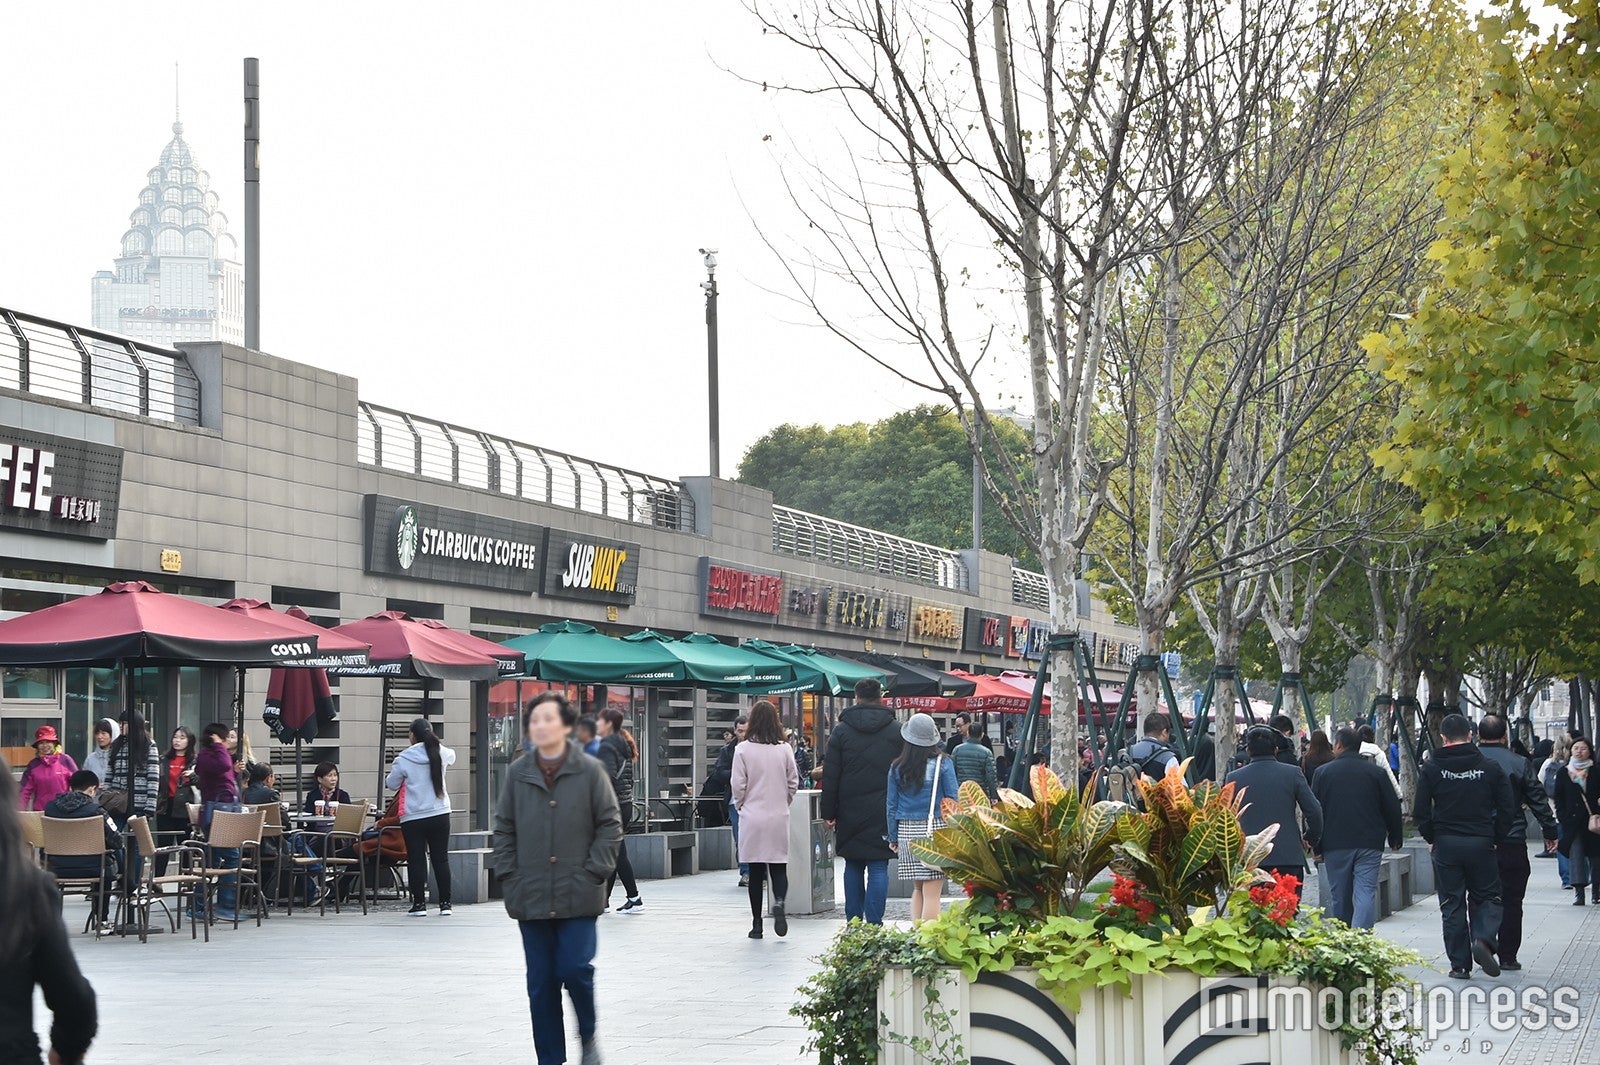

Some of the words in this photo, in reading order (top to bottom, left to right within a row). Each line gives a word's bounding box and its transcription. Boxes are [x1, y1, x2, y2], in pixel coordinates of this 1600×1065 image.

[421, 527, 493, 563] STARBUCKS
[494, 539, 535, 570] COFFEE
[562, 542, 627, 592] SUBWAY
[271, 642, 312, 656] COSTA
[342, 654, 367, 666] COFFEE
[377, 663, 402, 674] COFFEE
